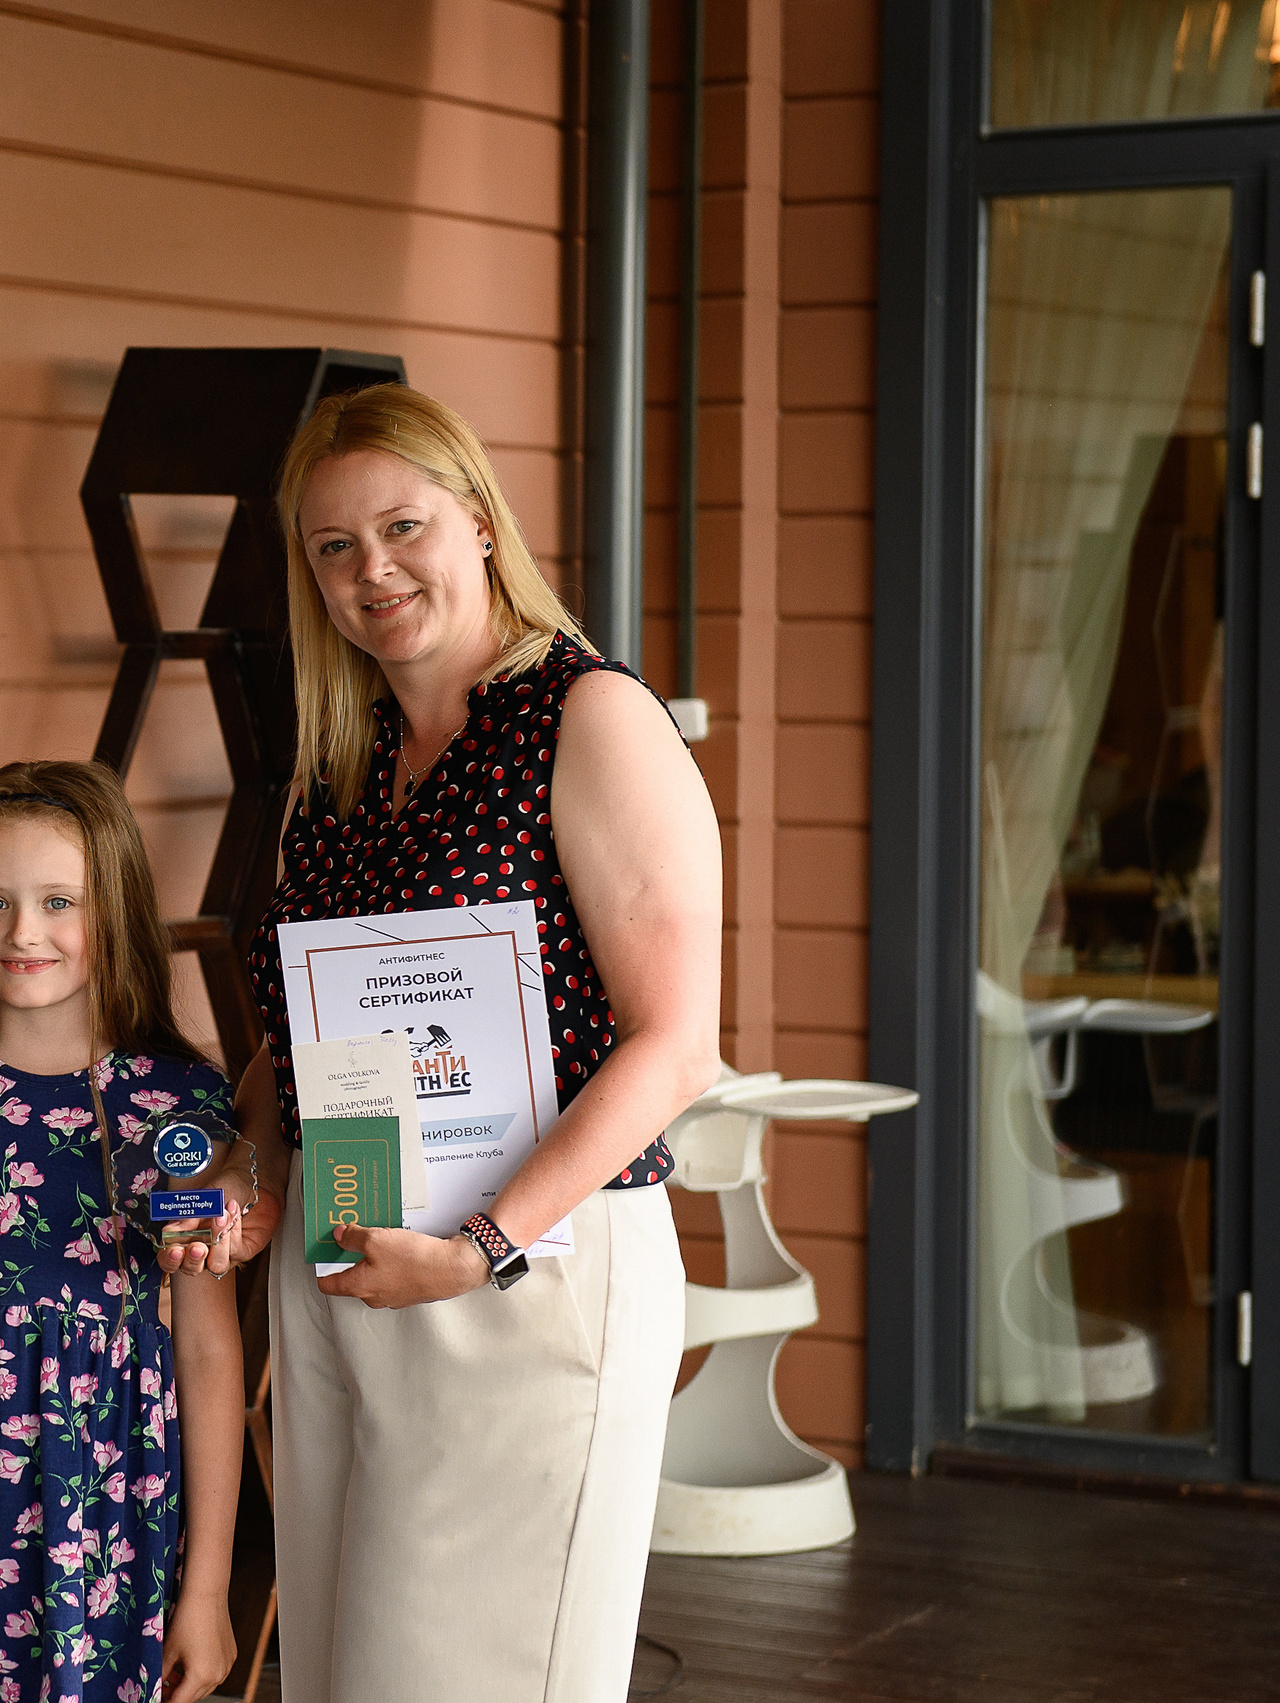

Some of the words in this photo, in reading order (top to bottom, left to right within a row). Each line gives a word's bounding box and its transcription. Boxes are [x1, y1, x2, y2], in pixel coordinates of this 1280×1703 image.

[378, 952, 446, 966] АНТИФИТНЕС
[365, 967, 463, 990] ПРИЗОВОЙ
[359, 987, 475, 1009] СЕРТИФИКАТ
[327, 1072, 348, 1081] OLGA
[347, 1068, 381, 1078] VOLKOVA
[412, 1050, 467, 1085] АНТИ
[323, 1095, 394, 1113] ПОДАРОЧНЫЙ
[164, 1151, 202, 1162] GORKI
[475, 1148, 504, 1160] Клуба
[159, 1202, 191, 1211] Beginners
[191, 1200, 213, 1210] Trophy
